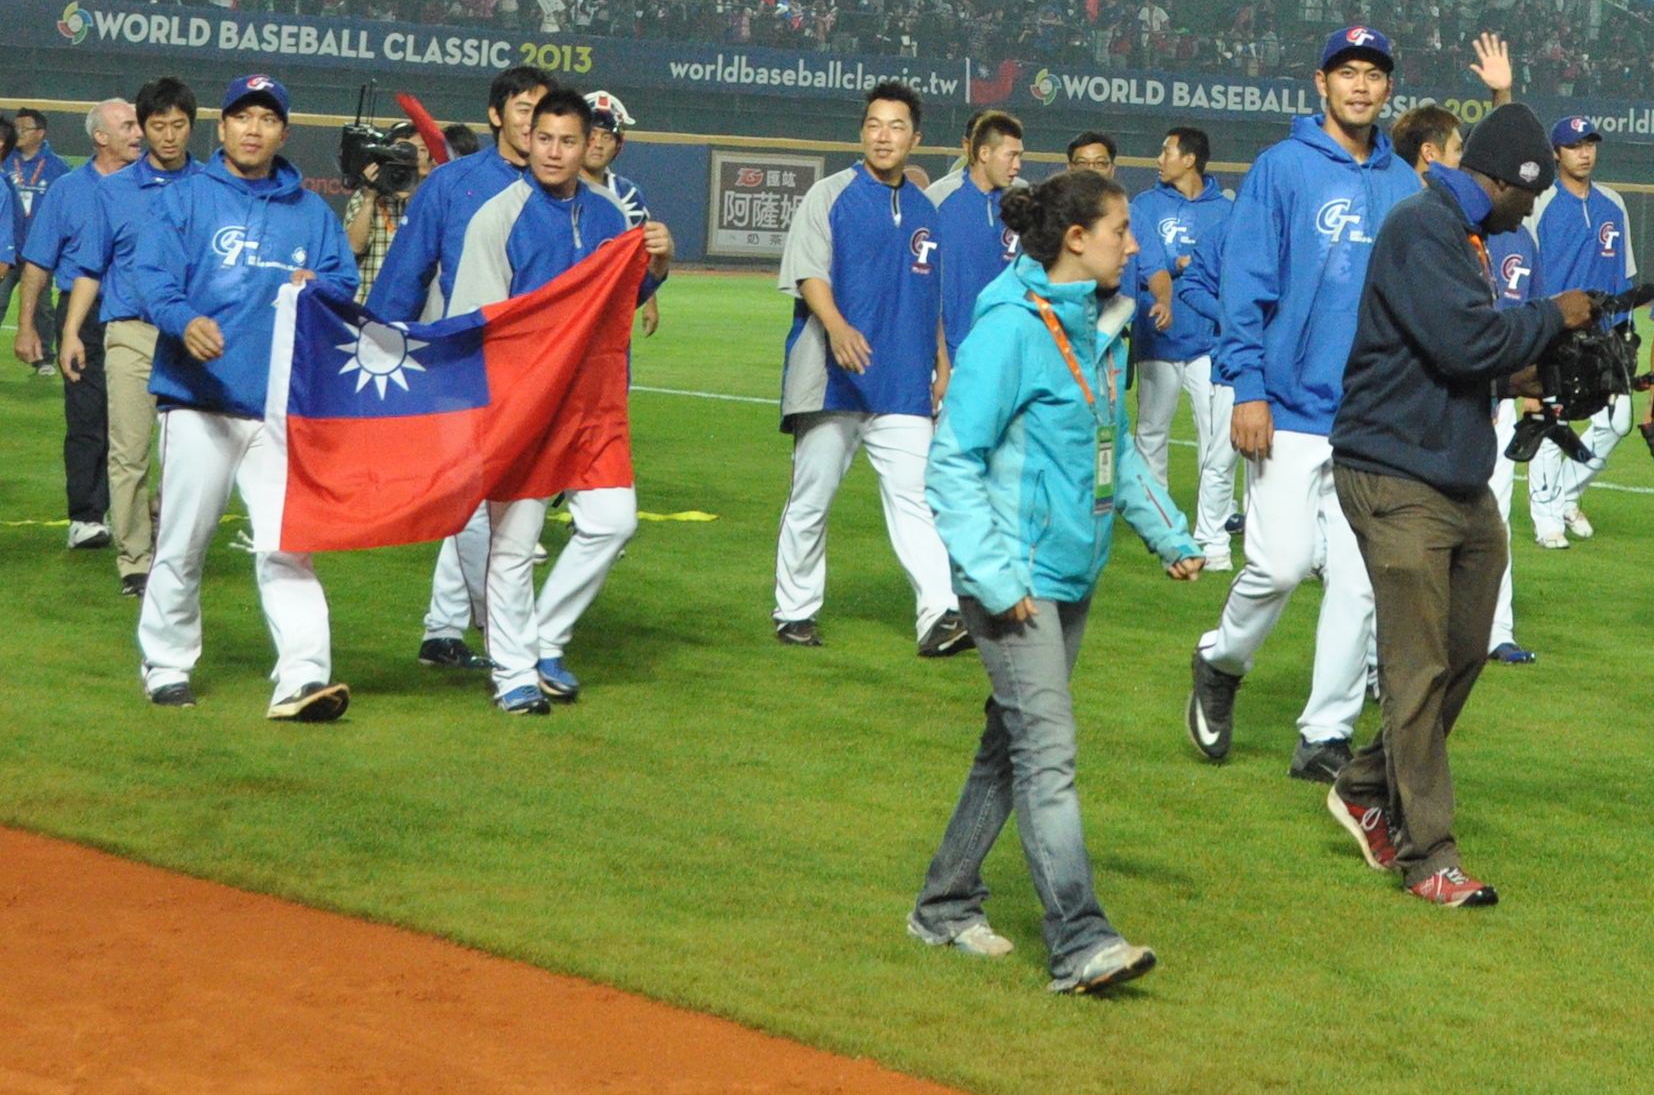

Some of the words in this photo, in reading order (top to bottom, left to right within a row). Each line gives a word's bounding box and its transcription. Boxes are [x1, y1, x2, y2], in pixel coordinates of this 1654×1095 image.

[93, 10, 211, 49] WORLD
[219, 21, 375, 59] BASEBALL
[382, 33, 512, 69] CLASSIC
[519, 42, 593, 73] 2013
[1063, 74, 1165, 105] WORLD
[1172, 81, 1313, 114] BASEBALL
